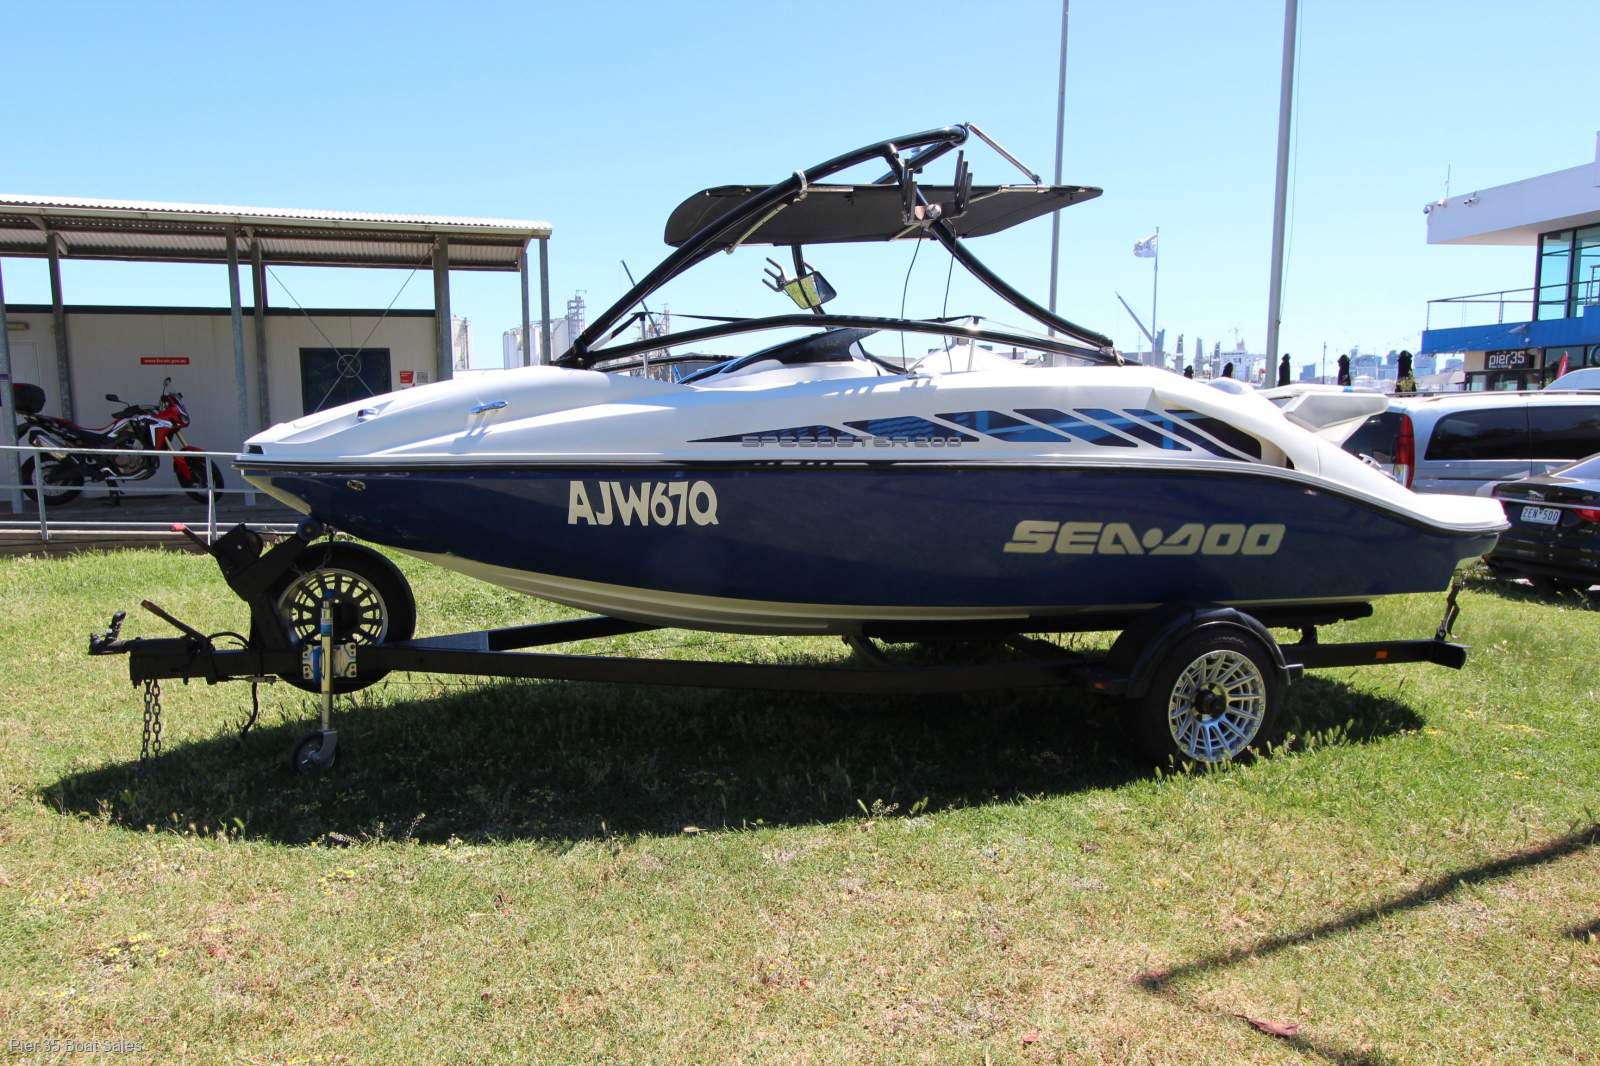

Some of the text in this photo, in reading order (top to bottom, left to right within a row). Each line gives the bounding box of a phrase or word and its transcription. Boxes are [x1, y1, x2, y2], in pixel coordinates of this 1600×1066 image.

[741, 436, 962, 448] SPEEDSTER 200
[567, 480, 720, 526] AJW67Q
